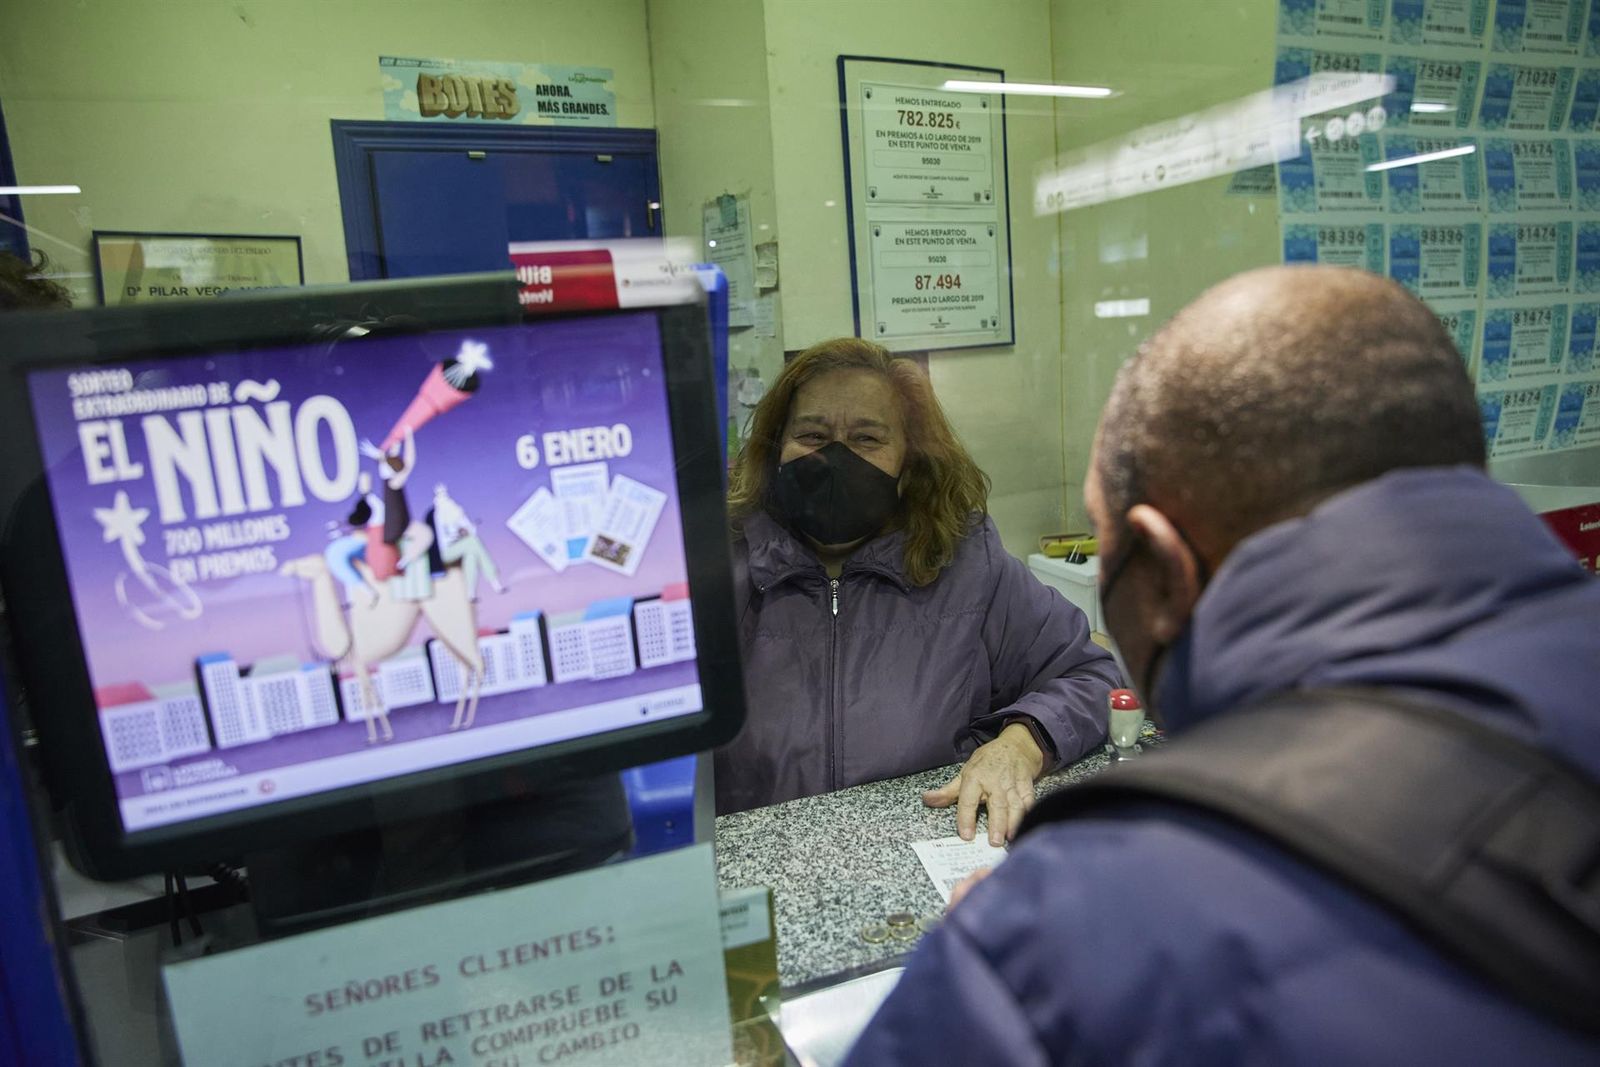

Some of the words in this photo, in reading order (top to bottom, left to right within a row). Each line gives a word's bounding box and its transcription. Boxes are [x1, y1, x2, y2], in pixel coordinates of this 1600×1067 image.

[417, 72, 521, 120] BOTES
[536, 84, 573, 98] AHORA,
[895, 97, 920, 106] HEMOS
[921, 98, 961, 108] ENTREGADO
[537, 99, 560, 113] MÁS
[562, 102, 610, 116] GRANDES.
[876, 130, 886, 138] EN
[887, 130, 918, 140] PREMIOS
[925, 132, 934, 141] LO
[935, 133, 957, 142] LARGO
[888, 140, 898, 148] EN
[899, 140, 915, 149] ESTE
[916, 142, 939, 150] PUNTO
[940, 142, 949, 151] DE
[950, 143, 971, 152] VENTA
[895, 237, 905, 245] EN
[906, 237, 921, 245] ESTE
[922, 237, 945, 245] PUNTO
[946, 237, 955, 245] DE
[955, 237, 977, 245] VENTA
[905, 229, 930, 237] HEMOS
[931, 229, 967, 237] REPARTIDO
[150, 286, 189, 297] PILAR
[915, 274, 961, 290] 87.494
[892, 296, 921, 305] PREMIOS
[928, 296, 938, 304] LO
[938, 295, 960, 304] LARGO
[961, 295, 970, 303] DE
[1513, 309, 1552, 327] 81474
[68, 368, 134, 397] SORTEO
[73, 384, 208, 421] EXTRAORDINARIO
[208, 381, 232, 405] DE
[78, 419, 144, 485] EL
[142, 378, 360, 524] NIÑO
[516, 434, 540, 470] 6
[542, 423, 633, 467] ENERO
[202, 514, 290, 551] MILLONES
[170, 558, 198, 582] EN
[198, 545, 277, 581] PREMIOS
[304, 963, 440, 1017] SEÑORES
[458, 925, 616, 978] CLIENTES:
[363, 1030, 402, 1059] DE
[421, 985, 581, 1043] RETIRARSE
[599, 971, 633, 998] DE
[650, 959, 684, 984] LA
[471, 999, 627, 1057] COMPRUEBE
[645, 986, 678, 1011] SU
[538, 1022, 641, 1064] CAMBIO
